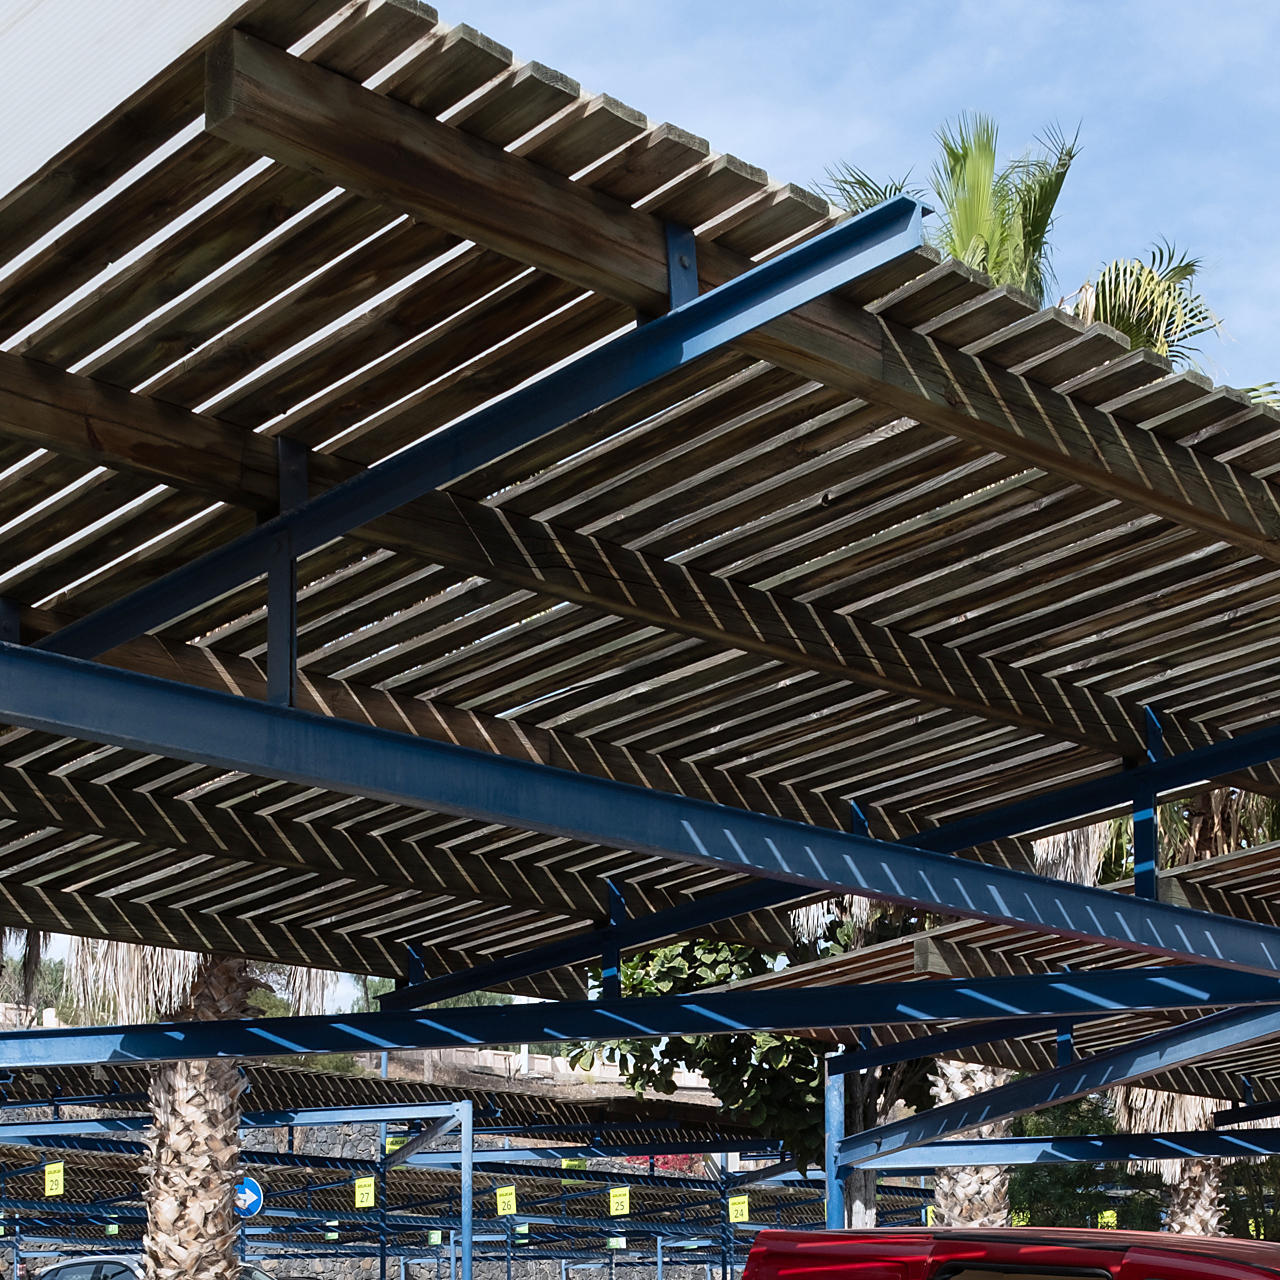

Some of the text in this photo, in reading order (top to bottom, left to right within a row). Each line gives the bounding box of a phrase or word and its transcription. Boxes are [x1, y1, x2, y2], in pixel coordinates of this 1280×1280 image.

[49, 1180, 59, 1191] 29
[360, 1192, 370, 1203] 27
[502, 1201, 512, 1211] 26
[615, 1201, 625, 1211] 25
[734, 1209, 745, 1219] 24
